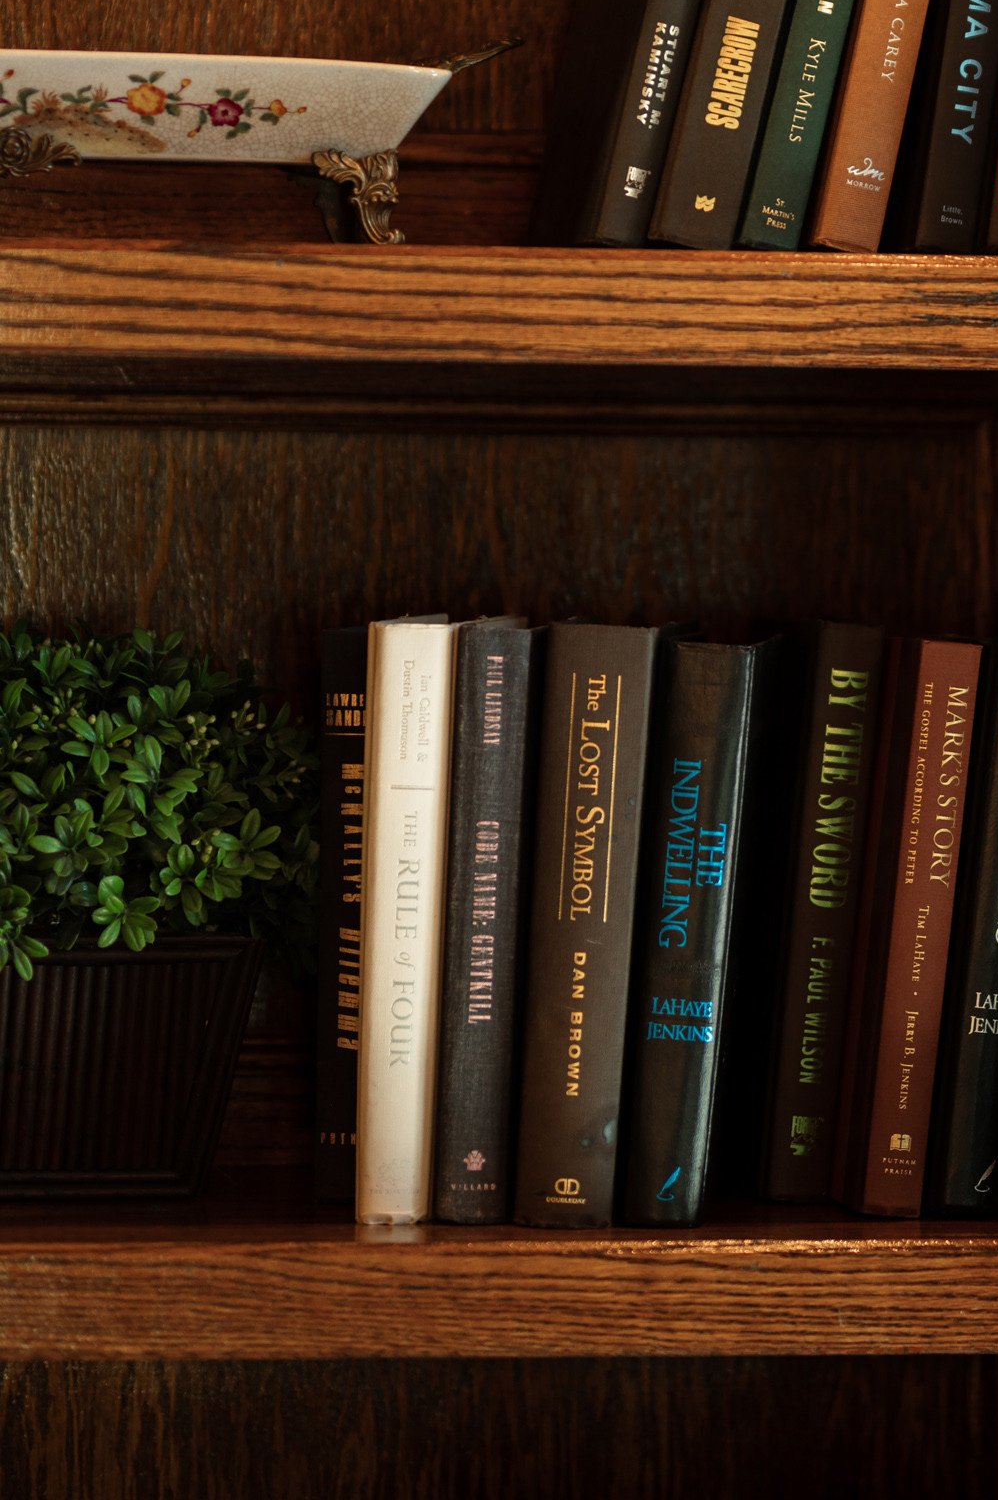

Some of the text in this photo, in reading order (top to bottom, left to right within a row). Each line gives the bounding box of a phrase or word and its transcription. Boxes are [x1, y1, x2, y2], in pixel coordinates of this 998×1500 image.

[637, 21, 668, 126] KAMINSKY
[648, 24, 681, 131] STUART M.
[705, 15, 761, 131] SCARECROW
[789, 36, 828, 144] KYLE MILLS
[881, 16, 907, 84] CAREY
[950, 57, 984, 146] CITY
[763, 204, 797, 221] MARTIN'S
[767, 214, 788, 231] PRESS
[846, 178, 882, 192] MORROW
[940, 214, 963, 227] Brown
[942, 204, 964, 216] Little,
[400, 660, 415, 761] Dustin Thomason
[483, 655, 504, 746] PAUL LINDSAY
[568, 674, 610, 922] The LOST SYMBOL
[809, 666, 871, 910] BY THE SWORD
[904, 681, 934, 887] THE GOSPEL ACCORDING TO PETER
[929, 684, 970, 895] MARK'S STORY
[657, 757, 702, 950] INDWELLING
[695, 822, 728, 888] THE
[390, 811, 421, 1070] THE RULE of FOUR
[468, 820, 501, 1026] CODE NAME: GENTKILL
[917, 904, 931, 932] TIM
[565, 951, 587, 1098] DAN BROWN
[645, 1020, 713, 1043] JENKINS
[799, 936, 836, 1086] F. PAUL WILSON
[905, 1010, 918, 1045] JERRY
[899, 1061, 913, 1111] JENKINS
[450, 1180, 496, 1191] VILLARD
[546, 1195, 586, 1205] DOUBLEDAY
[882, 1156, 917, 1167] PUTNAM
[884, 1167, 914, 1177] PRAISE
